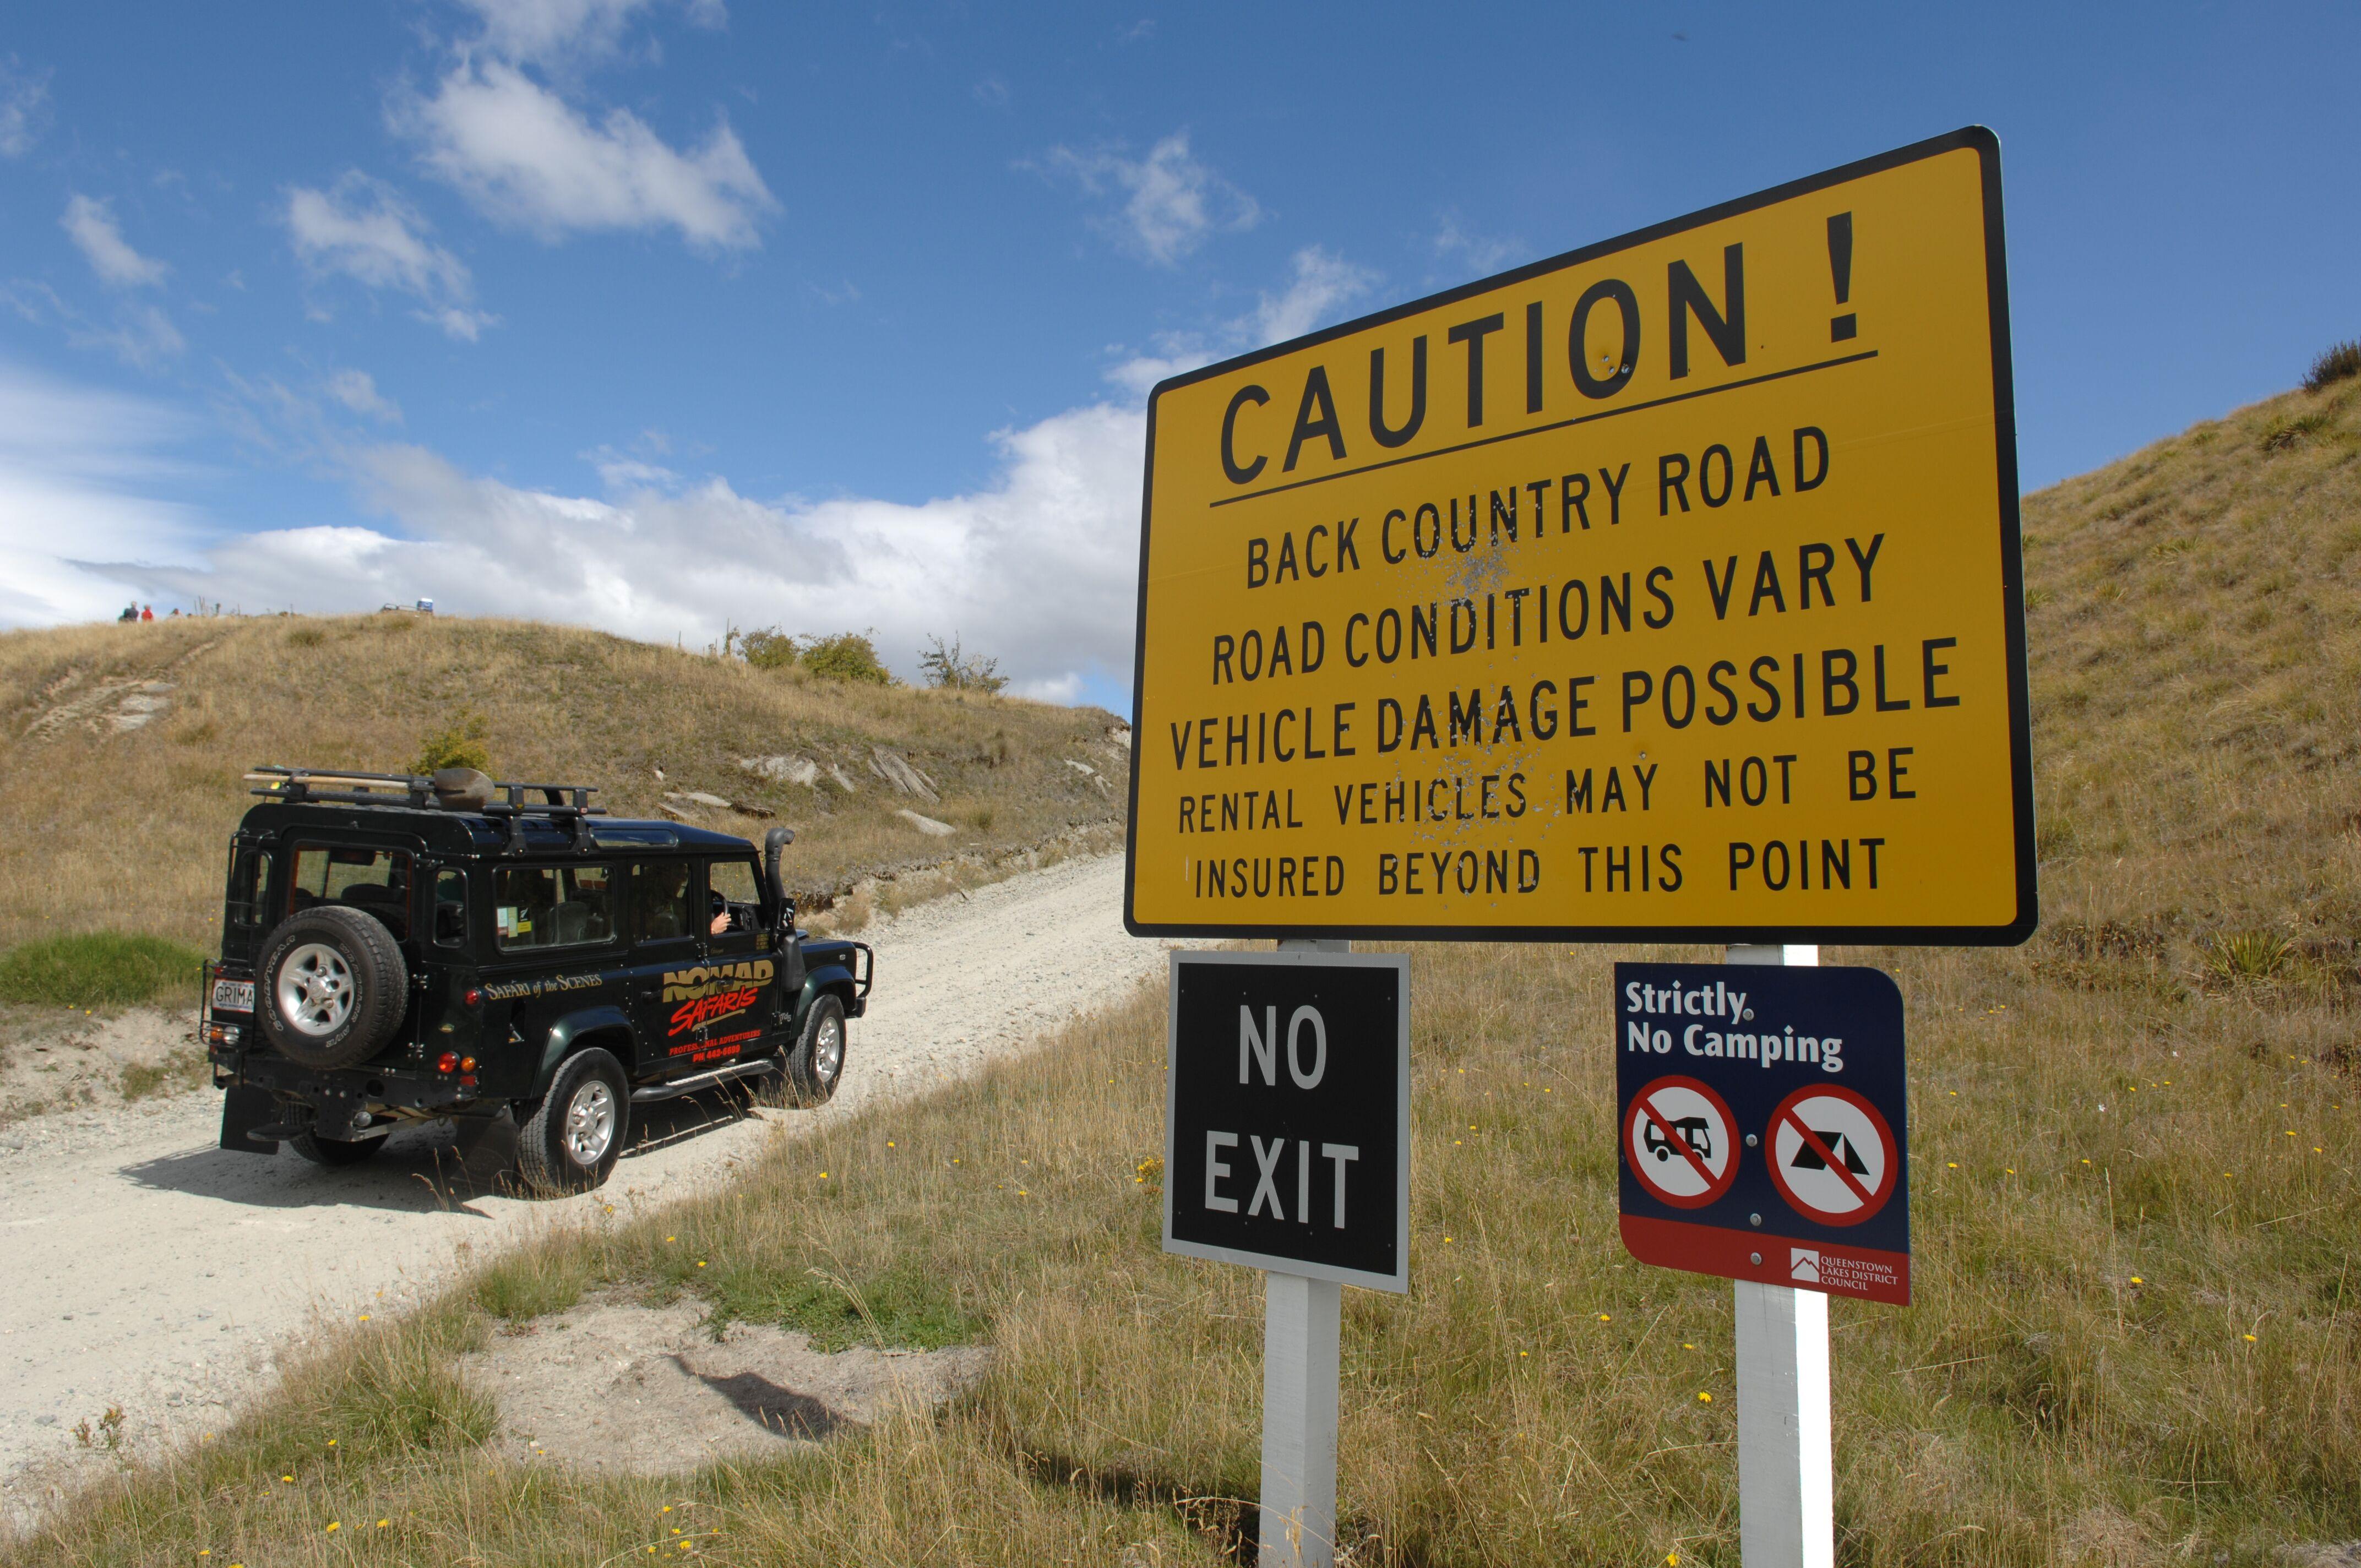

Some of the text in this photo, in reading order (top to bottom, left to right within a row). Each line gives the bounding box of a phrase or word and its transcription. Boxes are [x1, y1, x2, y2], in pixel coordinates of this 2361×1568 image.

[1220, 242, 1747, 485] CAUTION
[1248, 427, 1829, 589] BACK COUNTRY ROAD
[1213, 533, 1885, 685] ROAD CONDITIONS VARY
[1171, 637, 1960, 770] VEHICLE DAMAGE POSSIBLE
[1179, 747, 1916, 834] RENTAL VEHICLES MAY NOT BE
[1195, 838, 1885, 898] INSURED BEYOND THIS POINT
[264, 935, 296, 1032] GOODYEAR
[485, 974, 603, 1000] SAFARI of the SCENES
[662, 960, 774, 1003] NOMAD
[1625, 980, 1747, 1025] Strictly
[668, 986, 758, 1037] SAFARIS
[669, 1028, 761, 1057] PROFESSNAL ADVENTURERS
[1239, 1005, 1326, 1090] NO
[1628, 1022, 1843, 1072] No Camping
[1205, 1130, 1359, 1229] EXIT
[1820, 1256, 1892, 1274] QUEENSTOWN
[1821, 1266, 1898, 1285] LAKES DISTRICT
[1821, 1276, 1868, 1291] COUNCIL
